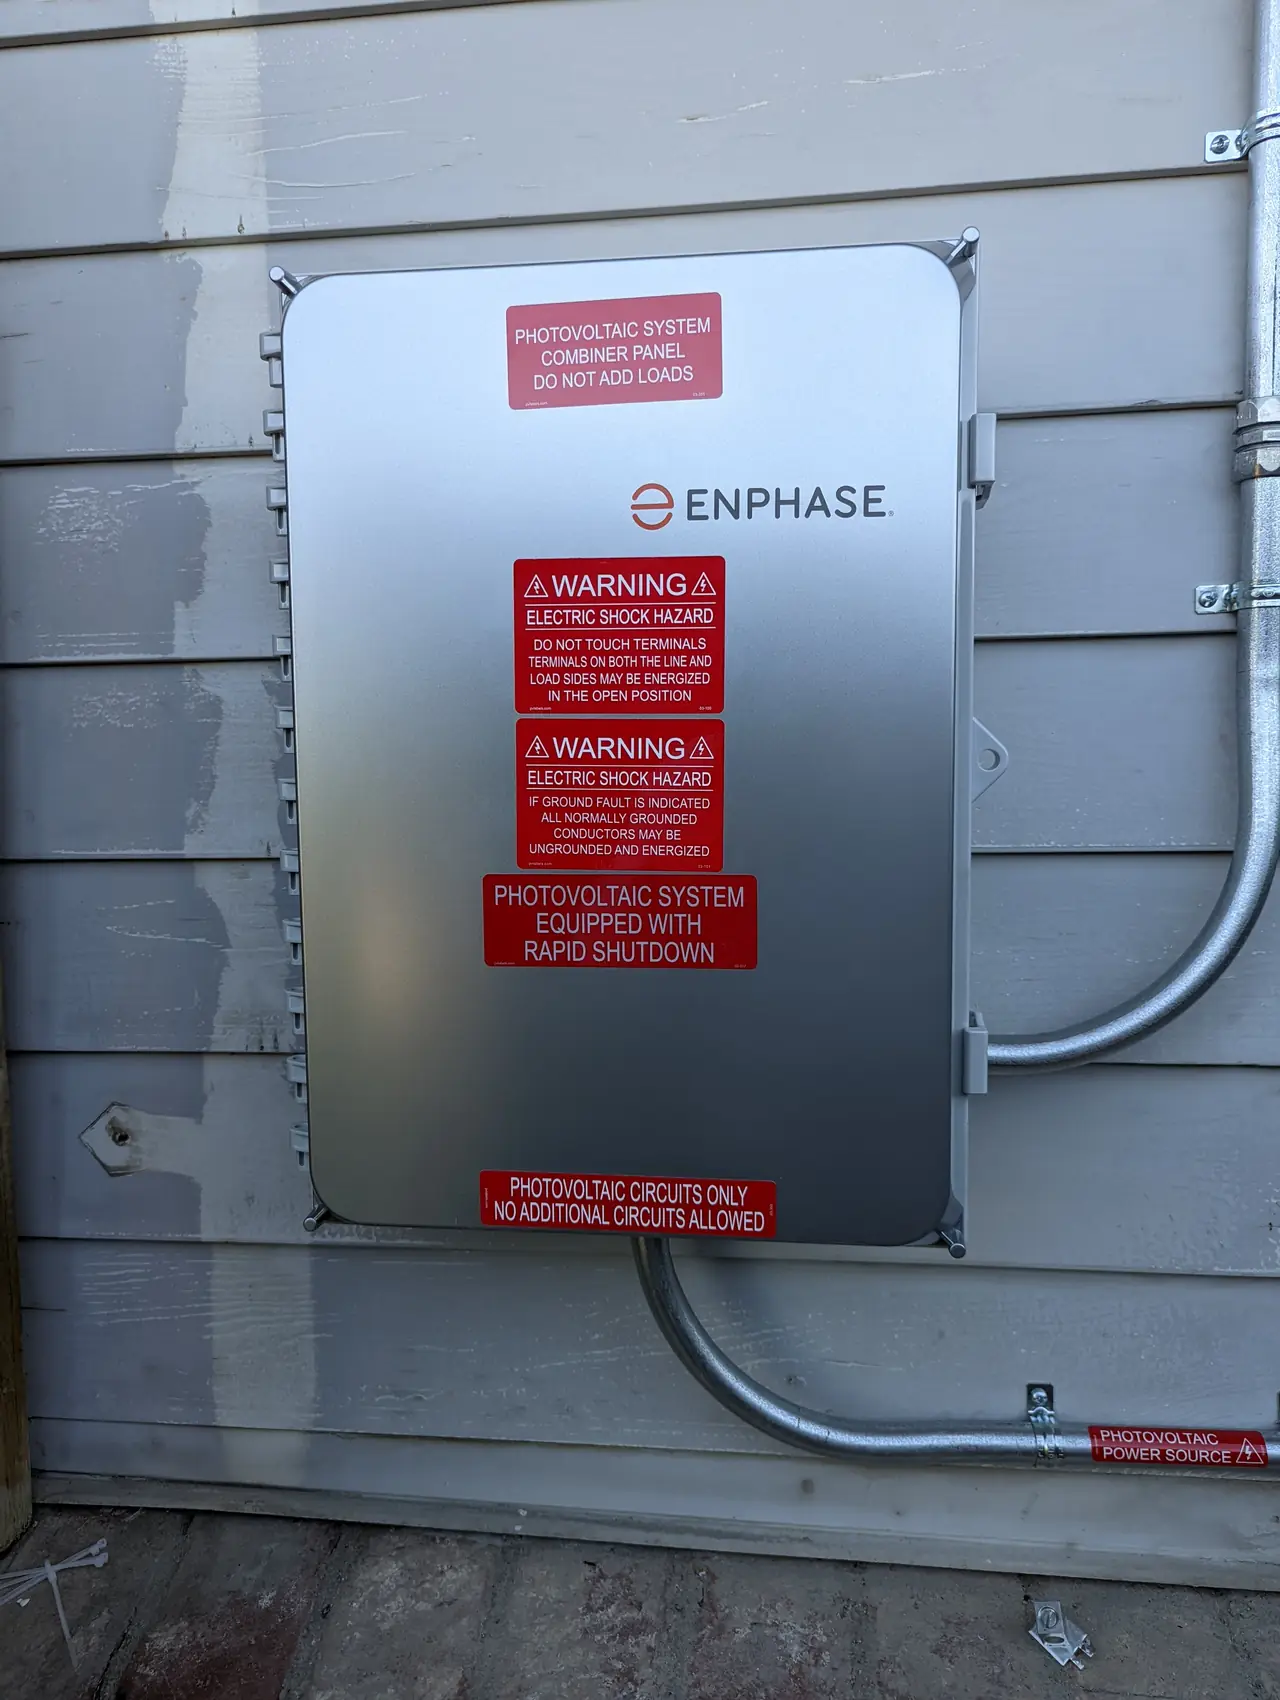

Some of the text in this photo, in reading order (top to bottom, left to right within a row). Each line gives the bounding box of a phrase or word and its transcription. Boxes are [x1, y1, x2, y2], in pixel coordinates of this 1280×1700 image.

[515, 317, 711, 344] PHOTOVOLTAIC SYSTEM
[541, 342, 685, 366] COMBINER PANEL
[534, 366, 693, 390] DO NOT ADD LOADS
[687, 485, 886, 520] ENPHASE
[552, 573, 686, 597] WARNING
[527, 608, 713, 625] ELECTRIC SHOCK HAZARD
[534, 638, 706, 650] DO NOT TOUCH TERMINALS
[529, 655, 712, 668] TERMINALS ON BOTH THE LINE AND
[530, 673, 710, 685] LOAD SIDES MAY BE ENERGIZED
[548, 690, 692, 701] IN THE OPEN POSITION
[553, 737, 685, 760] WARNING
[528, 771, 712, 787] ELECTRIC SHOCK HAZARD
[529, 797, 710, 809] IF GROUND FAULT IS INDICATED
[541, 813, 697, 825] ALL NORMALLY GROUNDED
[554, 828, 681, 840] CONDUCTORS MAY BE
[529, 844, 709, 857] UNGROUNDED AND ENERGIZED
[494, 885, 744, 908] PHOTOVOLTAIC SYSTEM
[536, 913, 701, 935] EQUIPPED WITH
[524, 940, 714, 963] RAPID SHUTDOWN
[510, 1177, 626, 1200] PHOTOVOLTAIC
[630, 1182, 702, 1204] CIRCUITS
[706, 1184, 748, 1206] ONLY
[494, 1201, 516, 1220] NO
[520, 1202, 609, 1225] ADDITIONAL
[613, 1205, 685, 1228] CIRCUITS
[689, 1208, 764, 1232] ALLOWED
[1100, 1430, 1218, 1445] PHOTOVOLTAIC
[1103, 1447, 1231, 1463] POWER SOURCE
